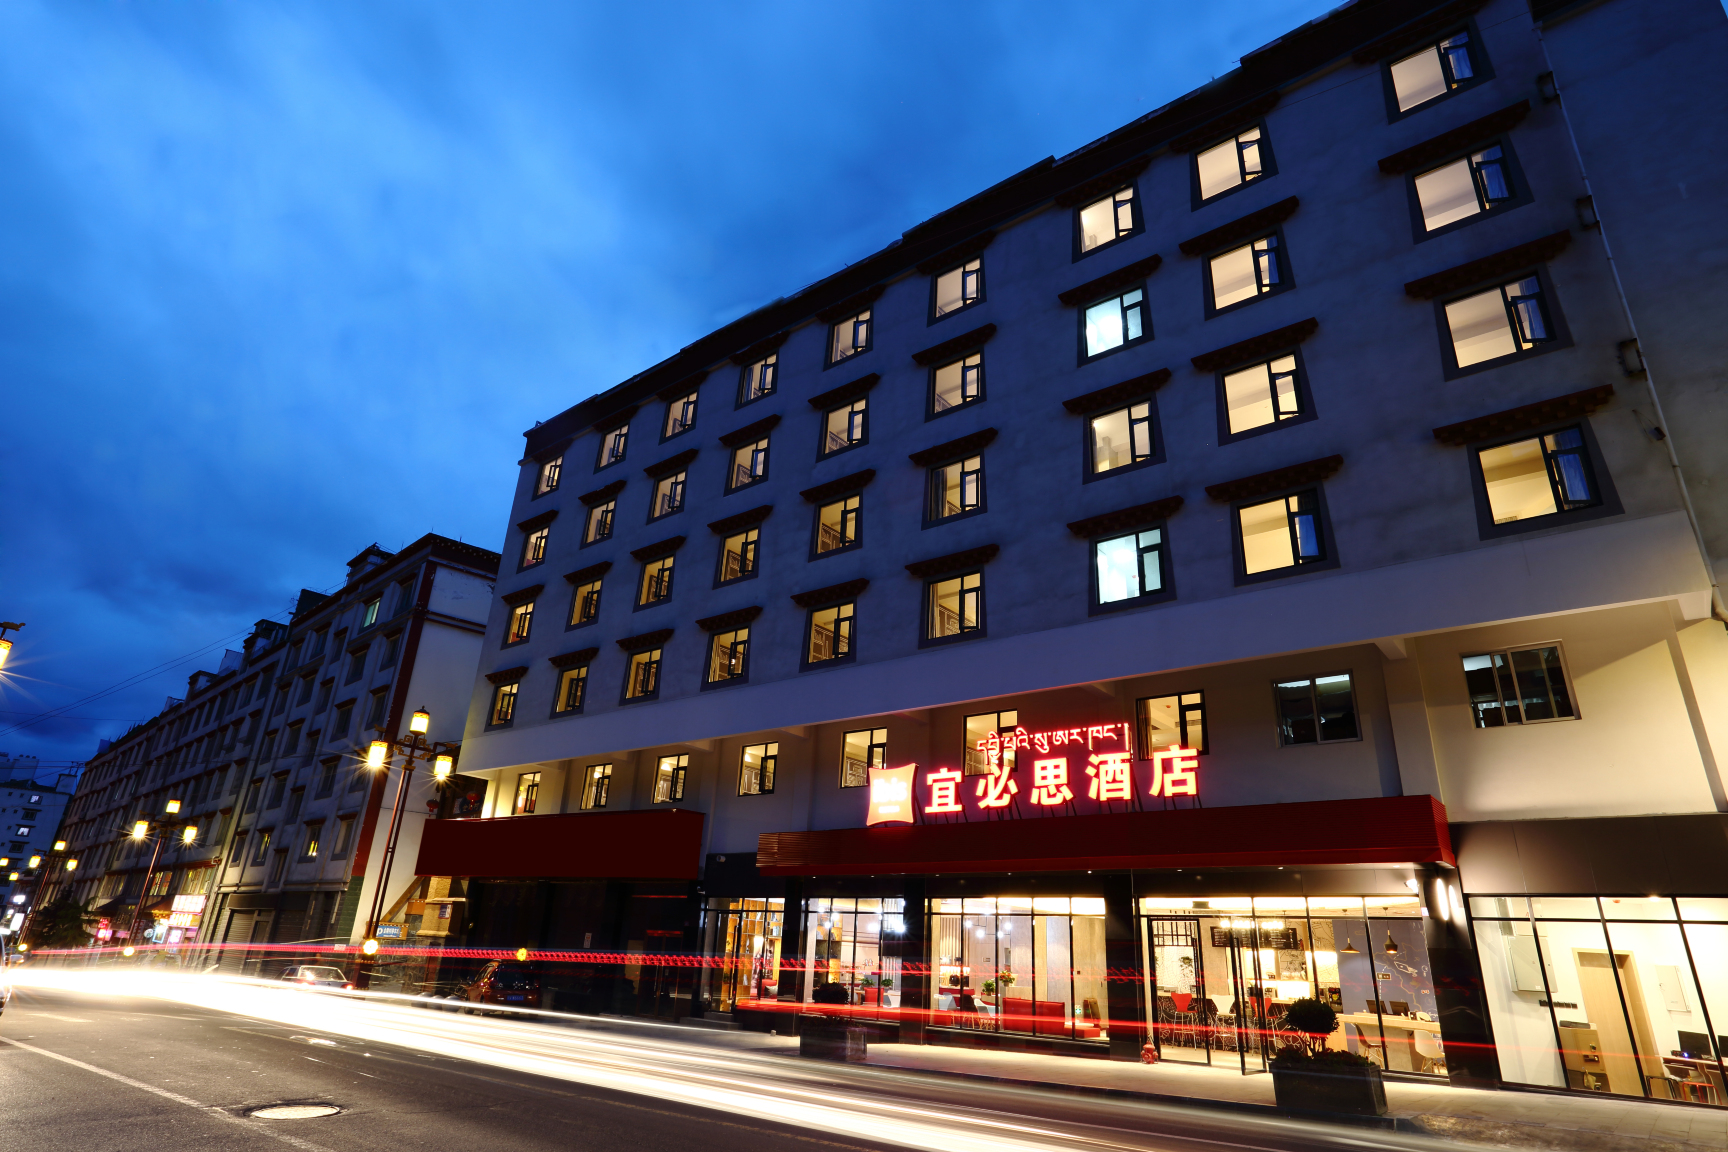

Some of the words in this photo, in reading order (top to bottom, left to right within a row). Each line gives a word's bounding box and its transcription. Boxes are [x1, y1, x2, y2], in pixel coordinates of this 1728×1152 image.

[925, 745, 1199, 814] 宜必思酒店
